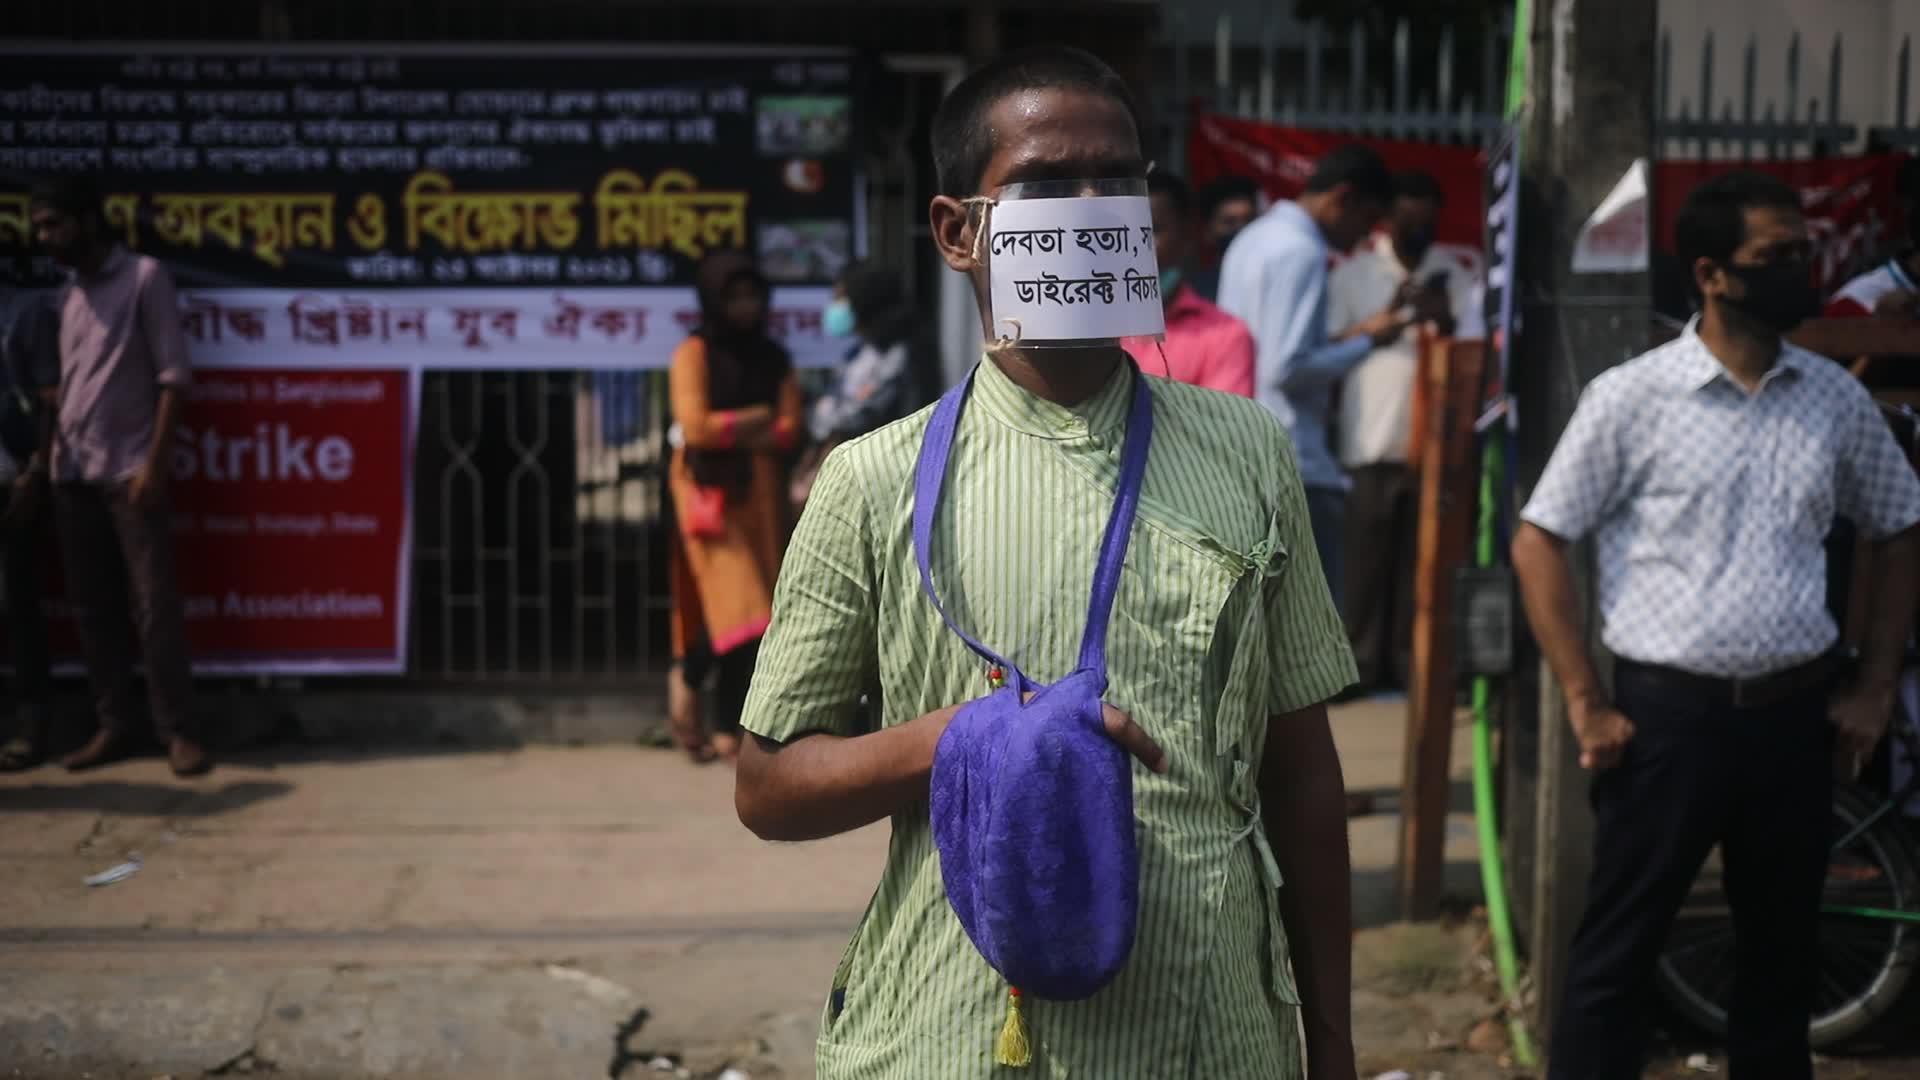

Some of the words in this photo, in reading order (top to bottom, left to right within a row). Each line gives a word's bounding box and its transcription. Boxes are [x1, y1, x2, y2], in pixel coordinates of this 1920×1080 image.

[153, 193, 335, 269] অবস্থান
[346, 194, 388, 250] ও
[405, 171, 582, 252] বিক্ষোভ
[594, 170, 748, 260] মিছিল
[991, 227, 1066, 256] দেবতা
[1073, 224, 1138, 257] হত্যা,
[1014, 271, 1117, 306] ডাইরেক্ট
[170, 421, 353, 481] Strike
[223, 590, 383, 619] Association
